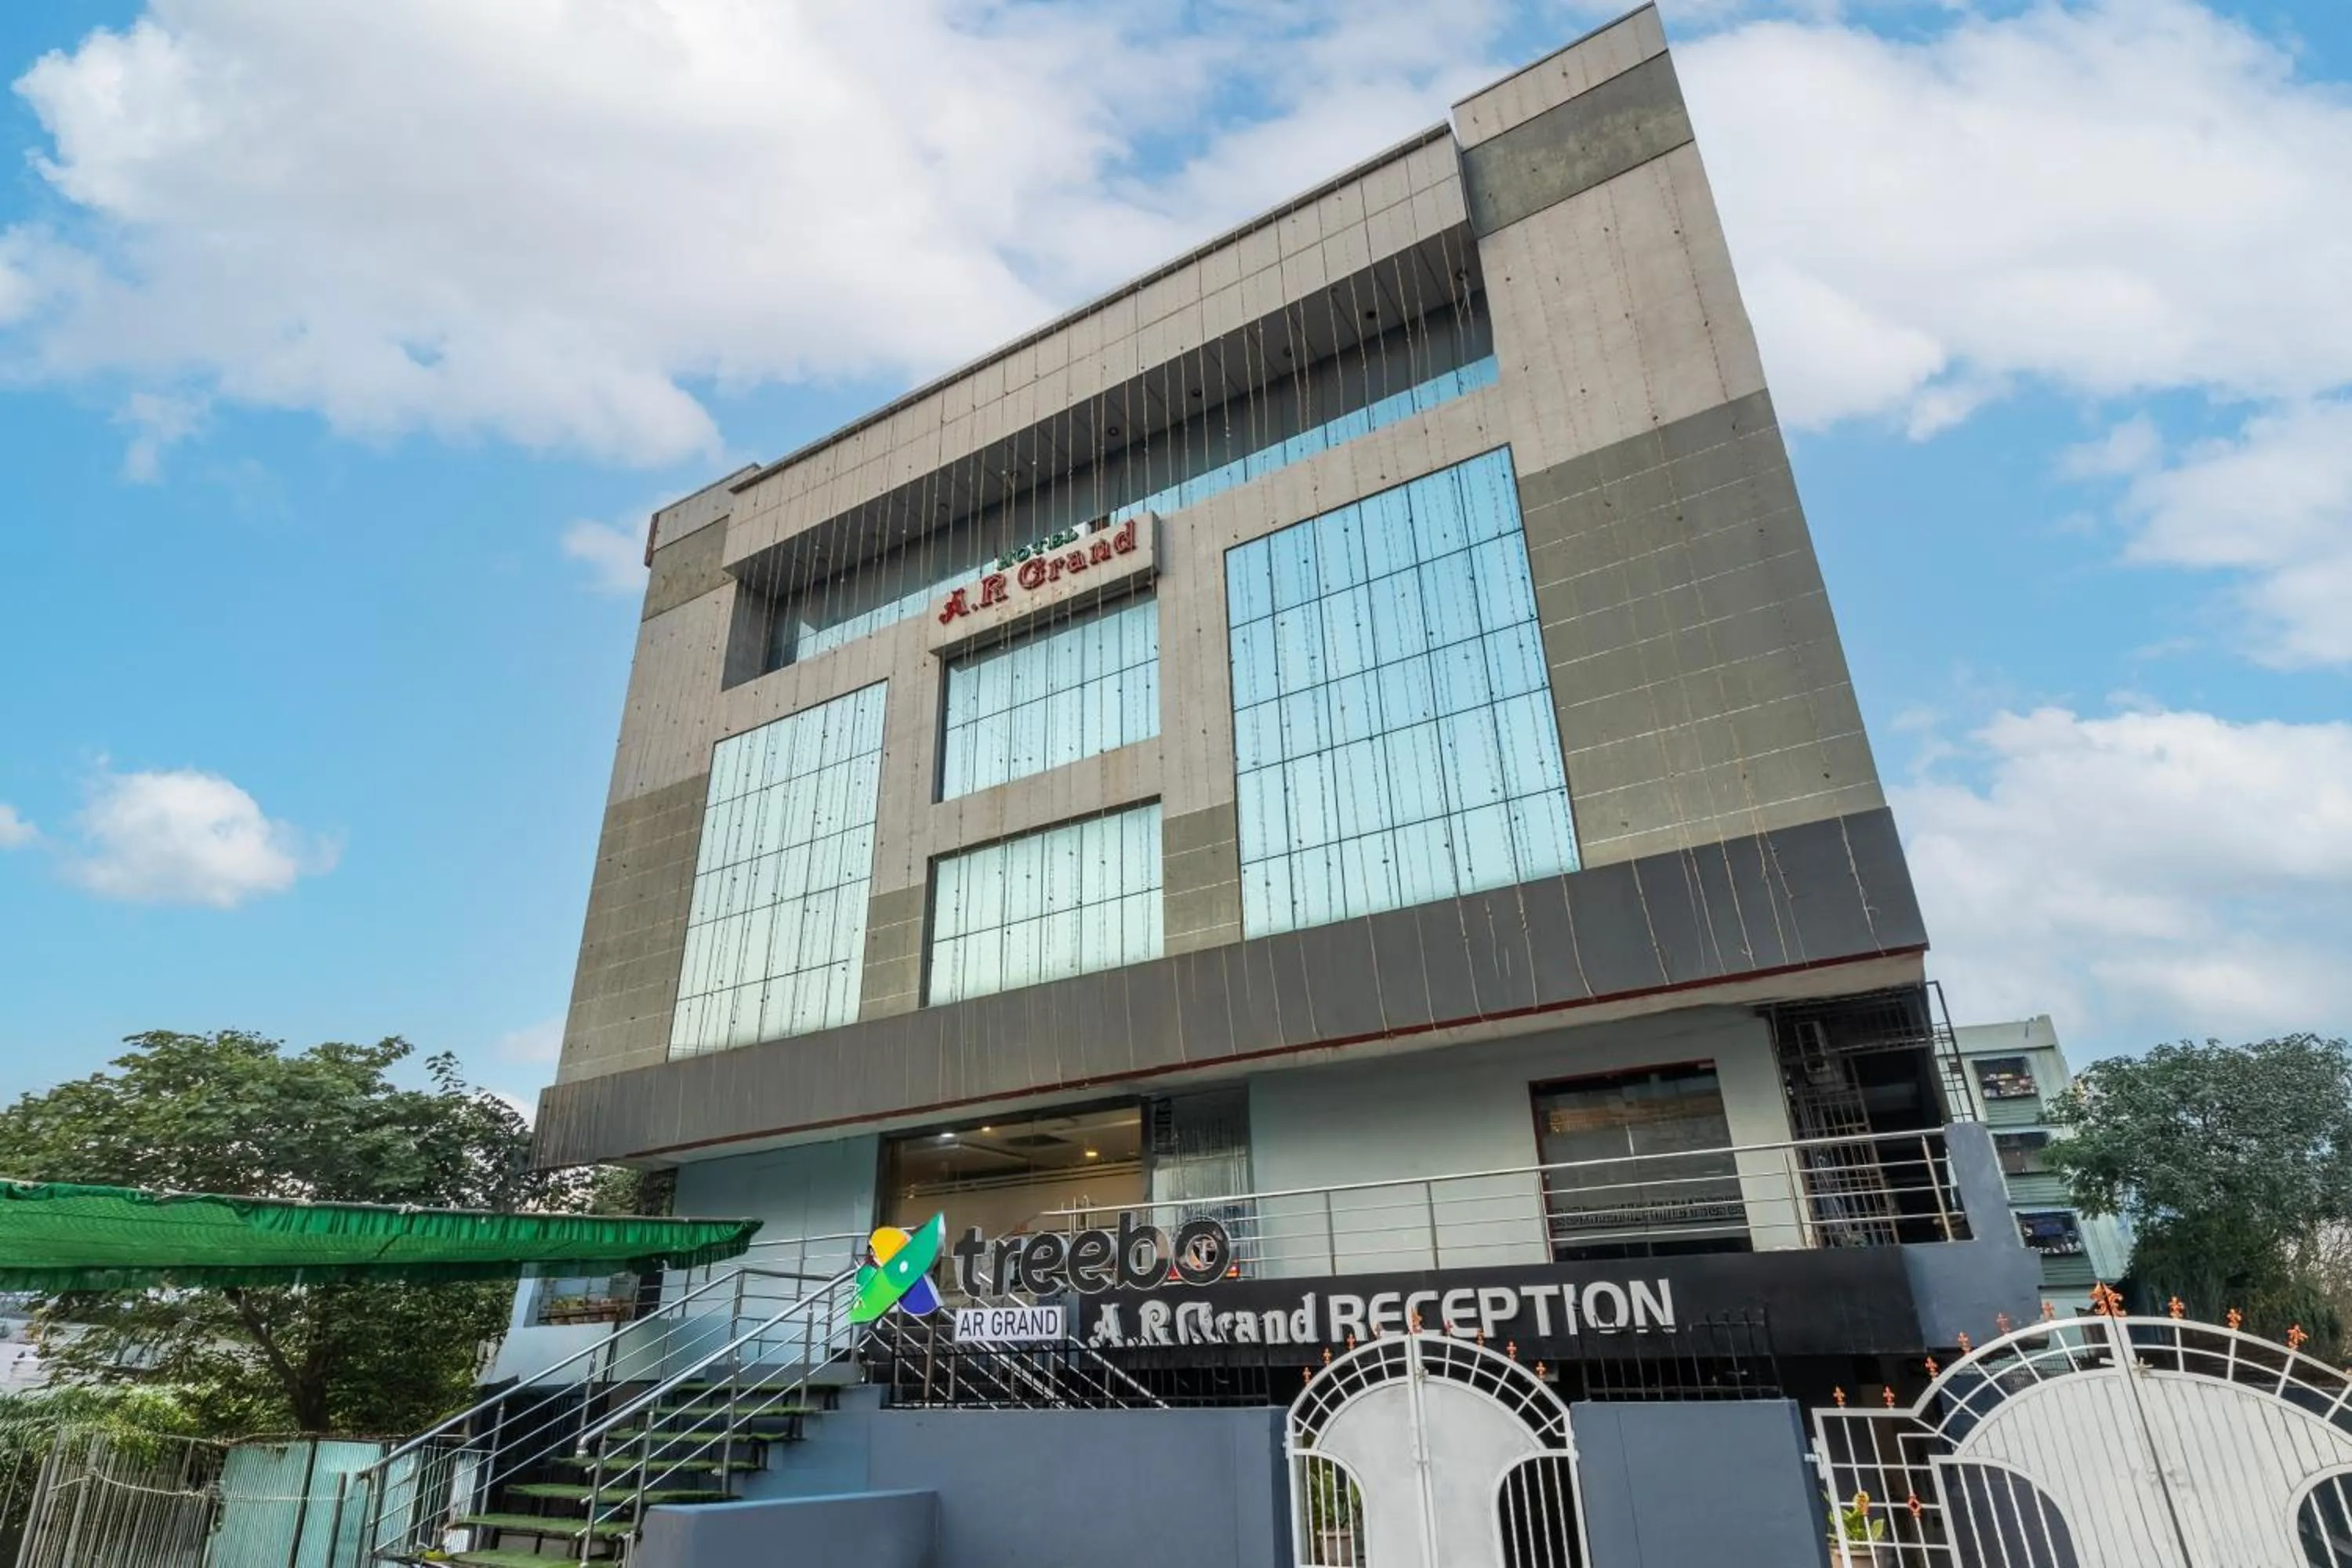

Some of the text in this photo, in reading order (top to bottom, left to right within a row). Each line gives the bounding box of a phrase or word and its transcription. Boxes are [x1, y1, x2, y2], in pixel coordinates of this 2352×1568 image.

[1018, 519, 1138, 590] Grand
[954, 1213, 1231, 1298] treebo
[959, 1309, 1058, 1336] AR GRAND
[1328, 1279, 1676, 1342] RECEPTION
